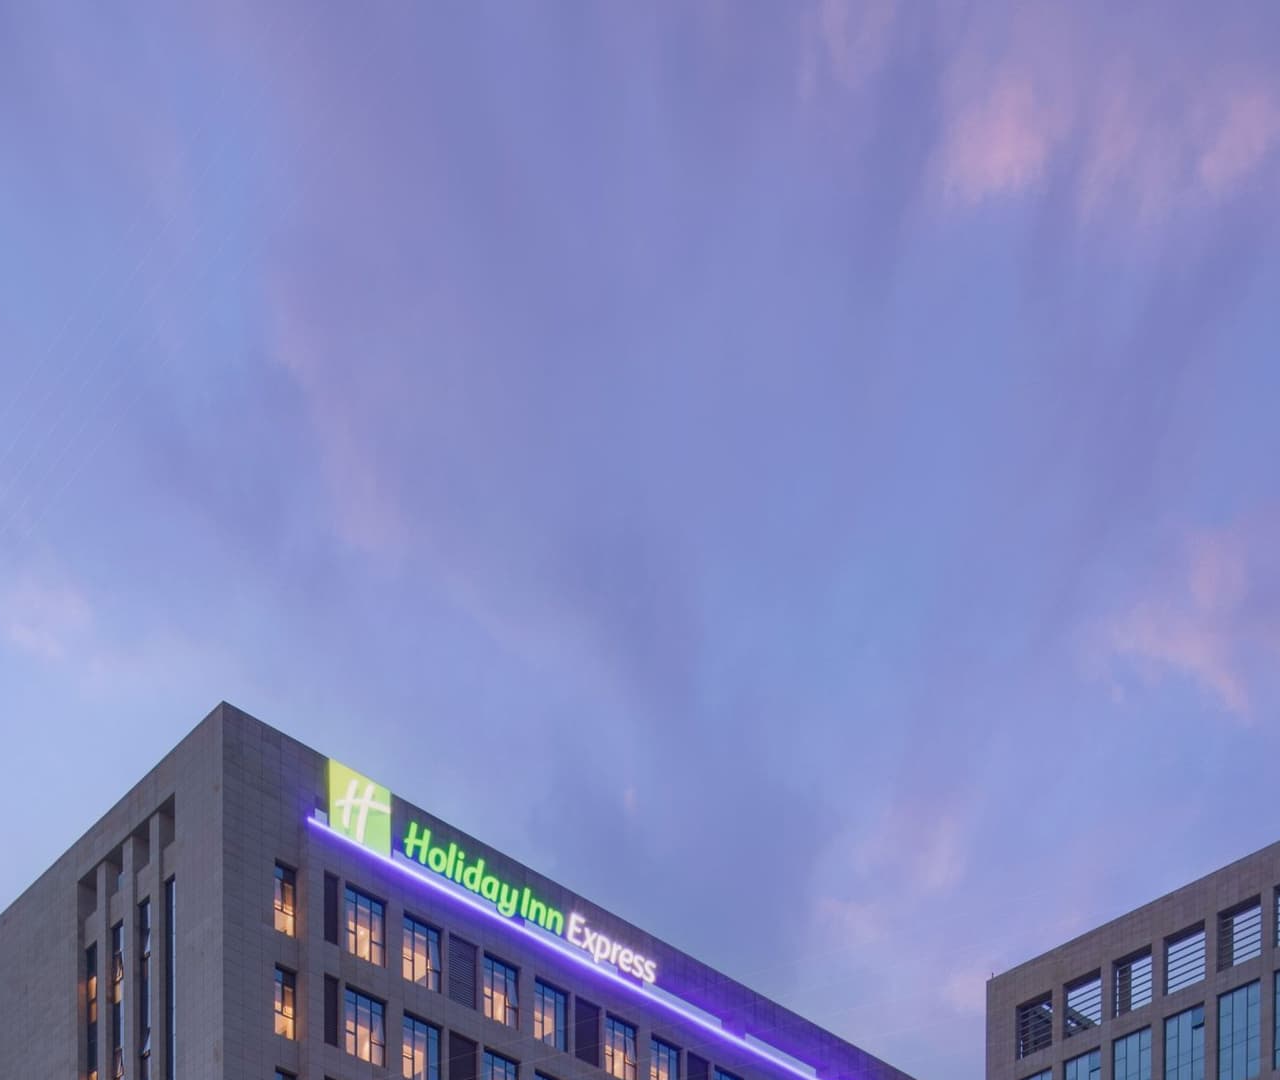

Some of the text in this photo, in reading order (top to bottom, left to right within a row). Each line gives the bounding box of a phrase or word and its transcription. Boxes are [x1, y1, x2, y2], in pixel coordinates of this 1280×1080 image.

[404, 821, 658, 984] Holiday Inn Express
